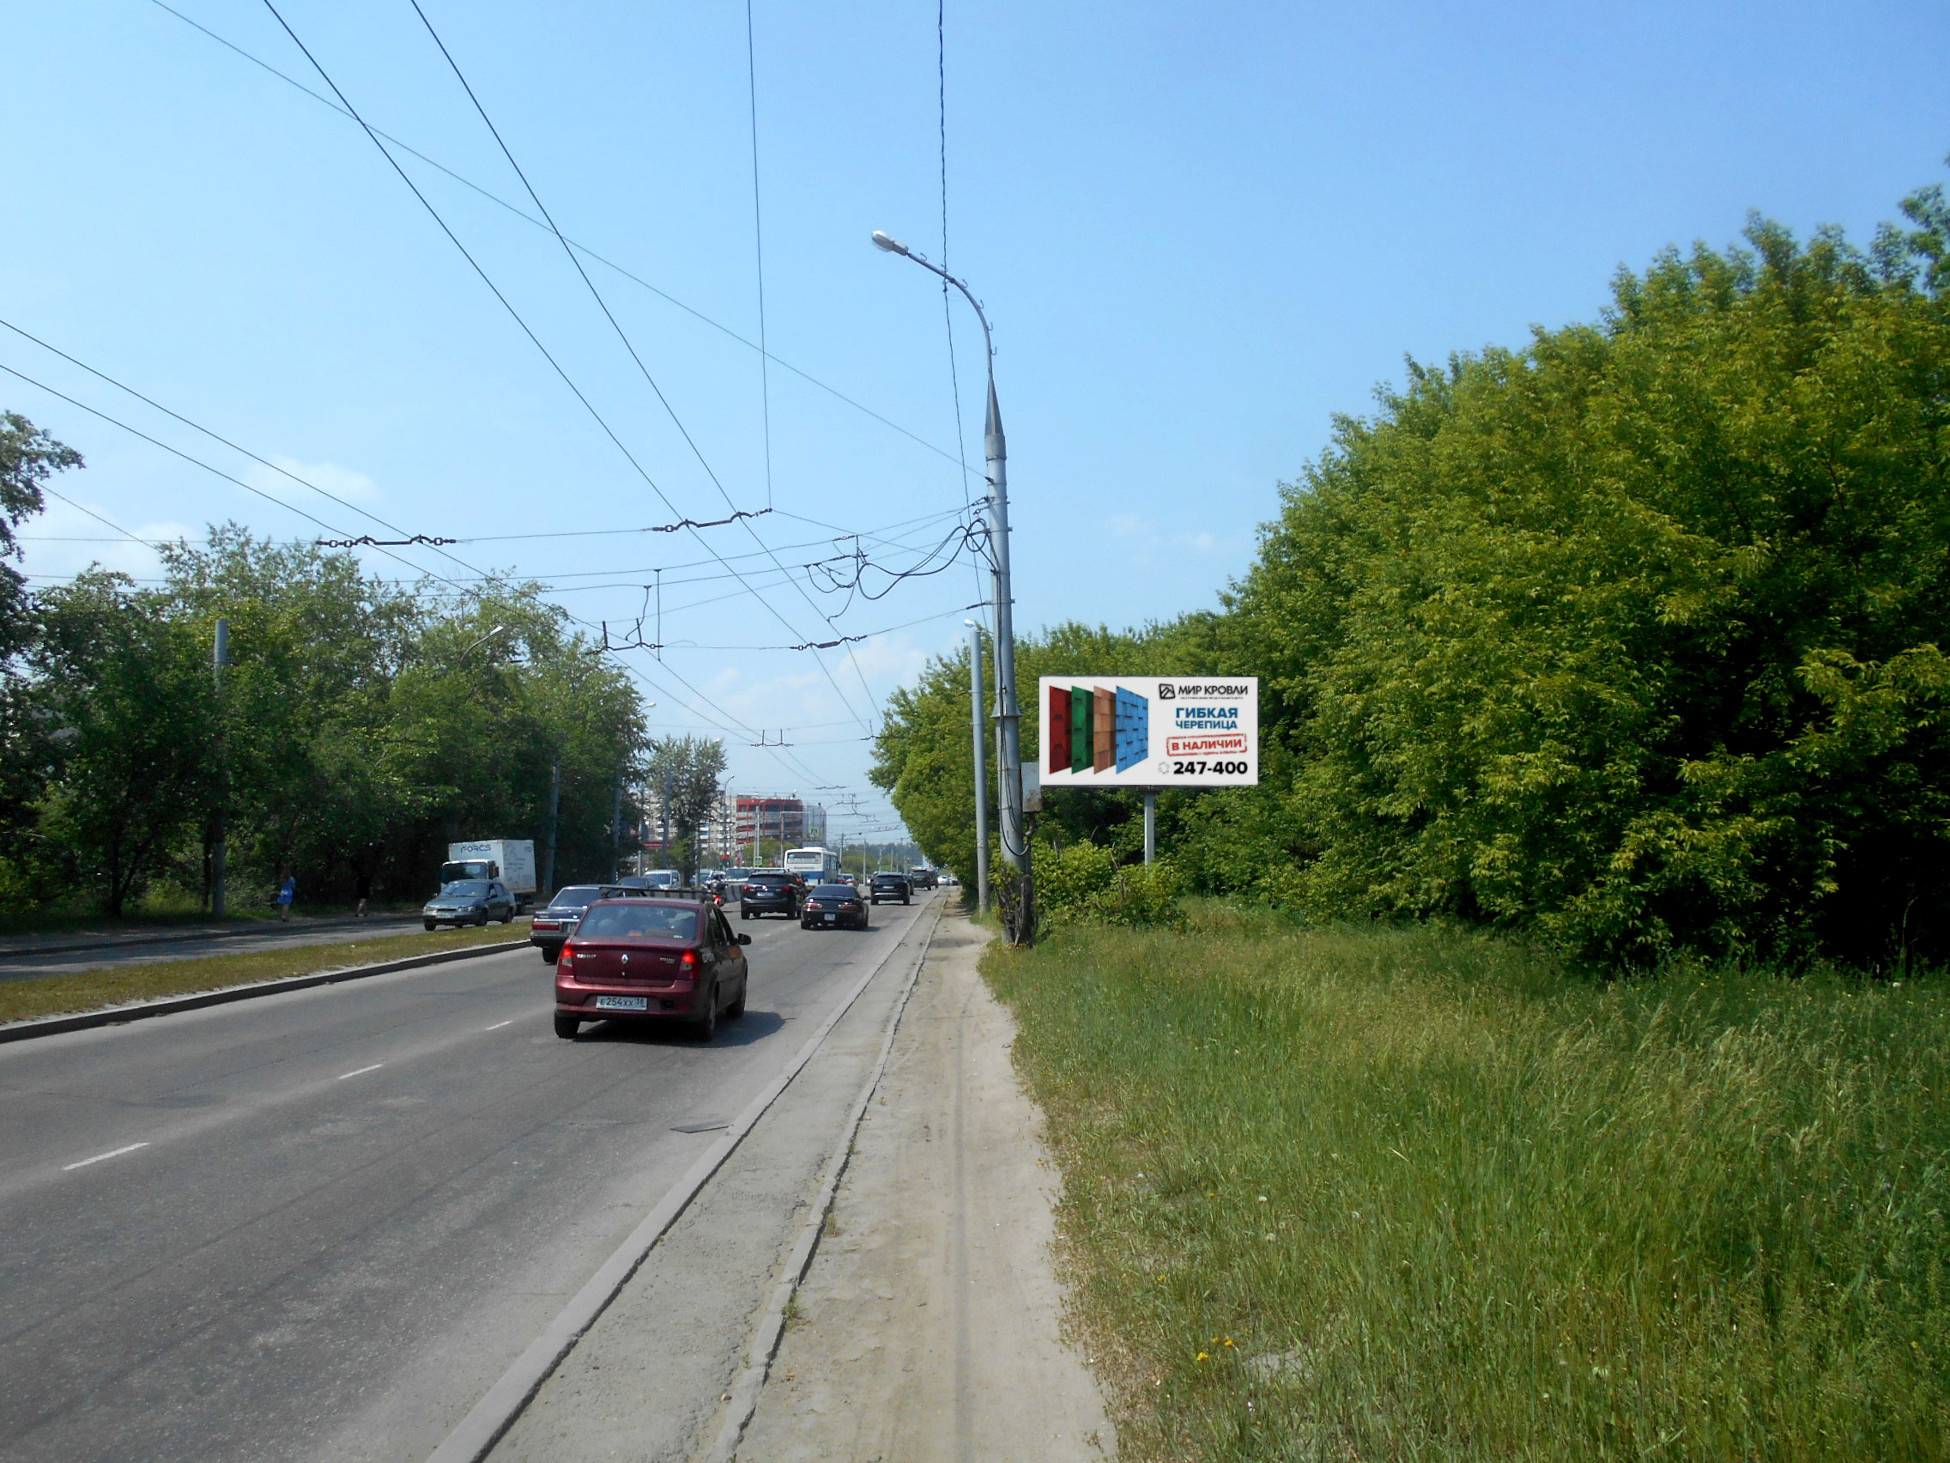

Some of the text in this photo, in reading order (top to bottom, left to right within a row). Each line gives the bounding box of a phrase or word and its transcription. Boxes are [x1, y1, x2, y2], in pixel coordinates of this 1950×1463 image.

[1178, 685, 1248, 695] МИР КРОВЛИ
[1176, 707, 1238, 718] ГИБКАЯ
[1175, 720, 1238, 730] ЧЕРЕПИЦА
[1171, 739, 1242, 751] В НАЛИЧИИ
[1173, 761, 1248, 775] 247-400
